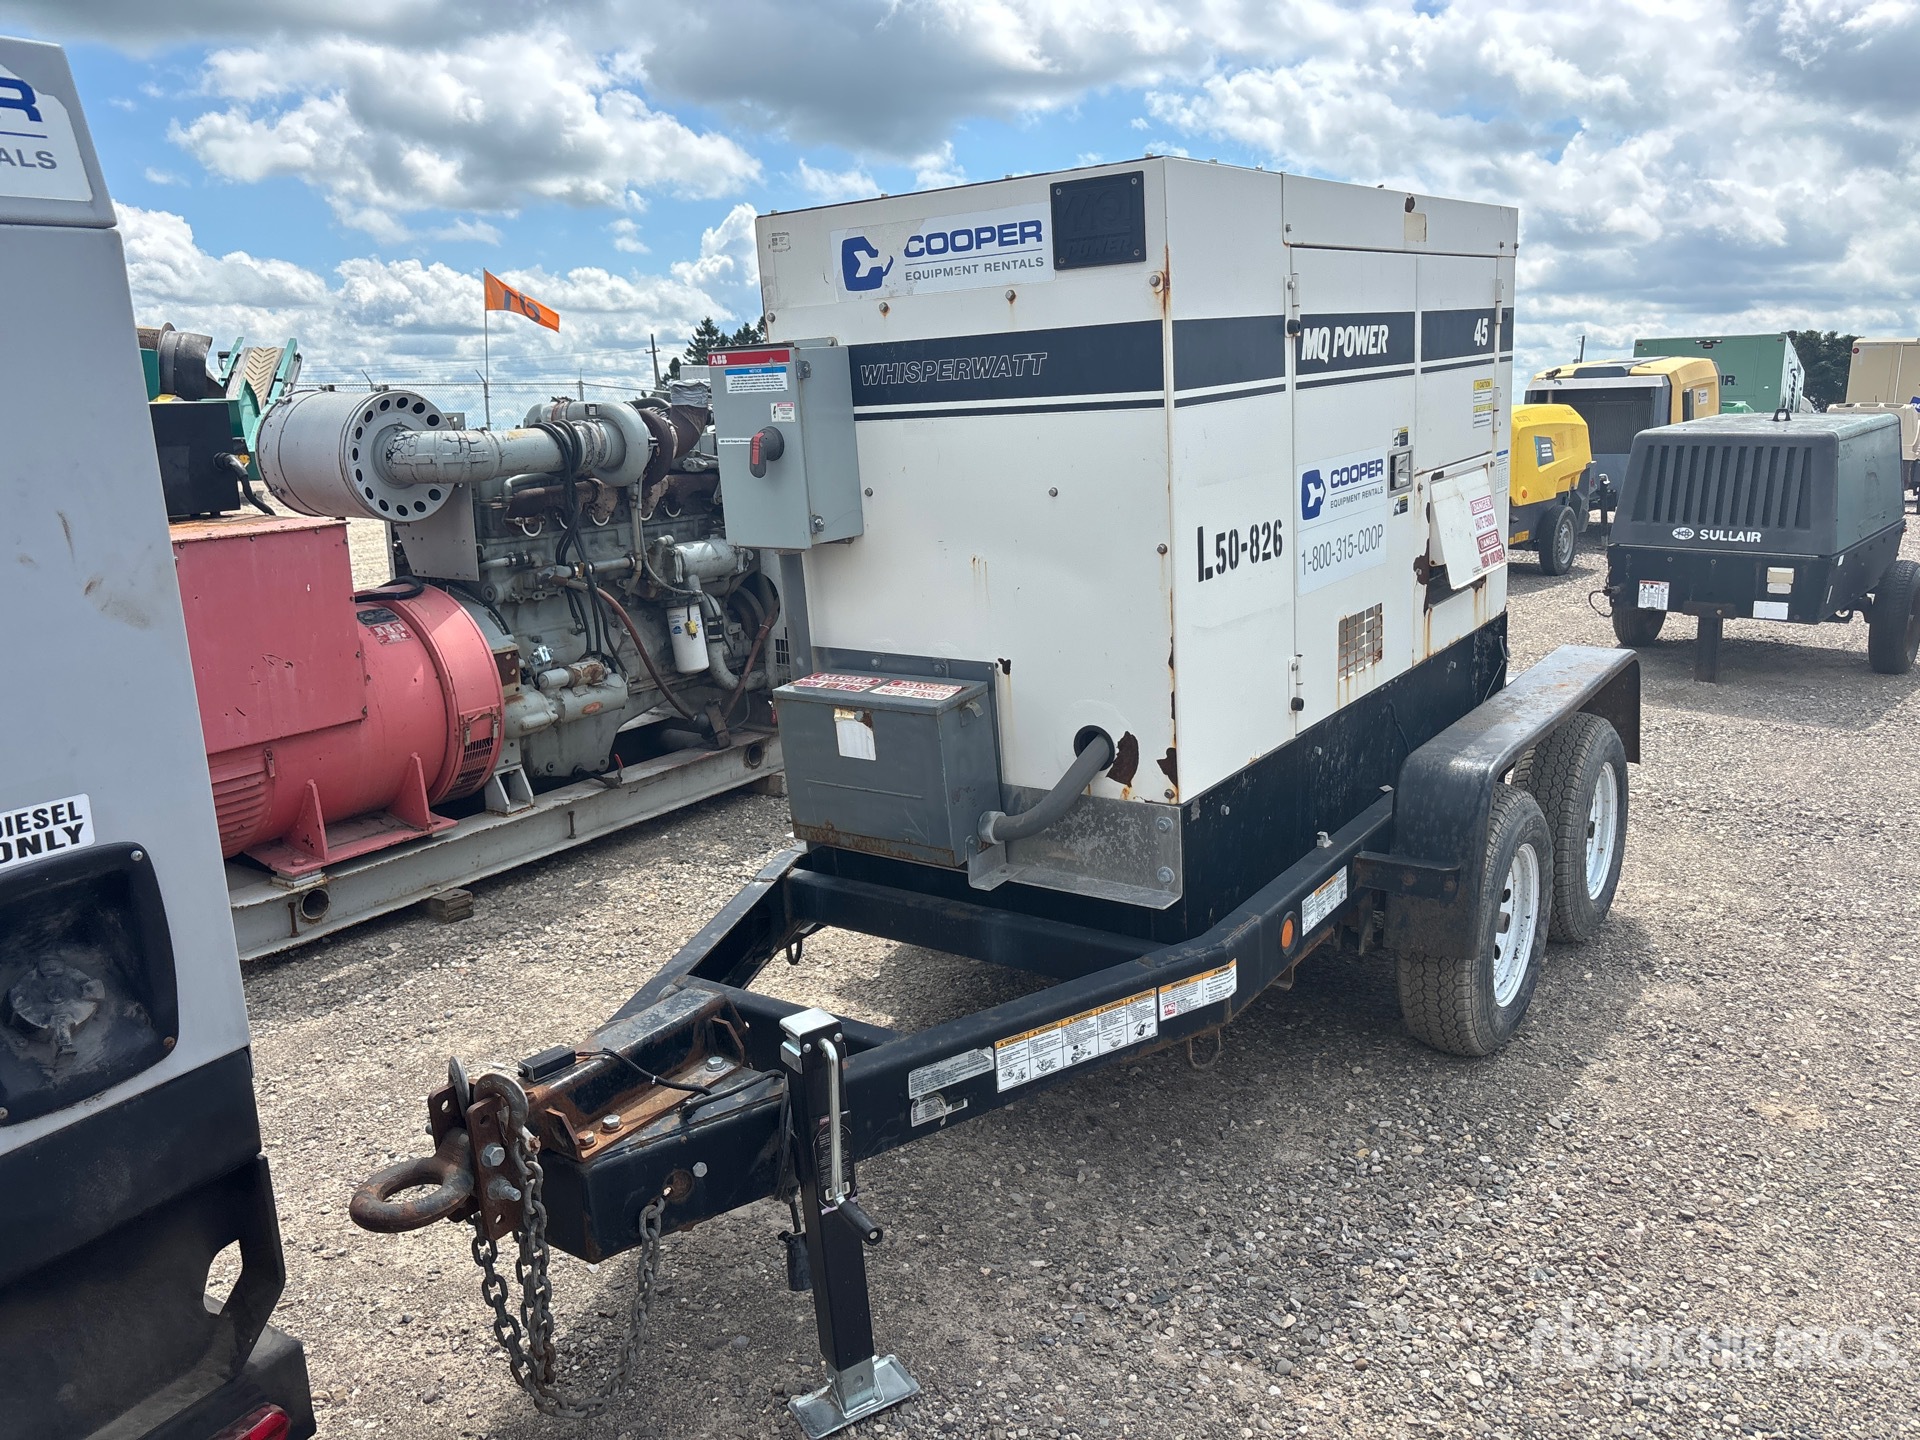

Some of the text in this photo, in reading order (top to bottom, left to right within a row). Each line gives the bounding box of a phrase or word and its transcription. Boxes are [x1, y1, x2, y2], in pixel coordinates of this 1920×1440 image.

[903, 219, 1043, 258] COOPER
[905, 256, 1044, 282] EQUIPMENT RENTALS
[1301, 324, 1389, 364] MQ POWER
[1474, 317, 1489, 347] 45
[711, 355, 728, 365] ABB
[860, 352, 1048, 386] WHISPERWATT
[1330, 458, 1384, 489] COOPER
[1330, 486, 1384, 509] EQUIPMENT RENTALS
[1301, 523, 1384, 576] 1-800-315-COOP
[1479, 534, 1498, 549] DANGER
[1699, 529, 1762, 543] SULLAIR
[0, 801, 83, 838] IESEL
